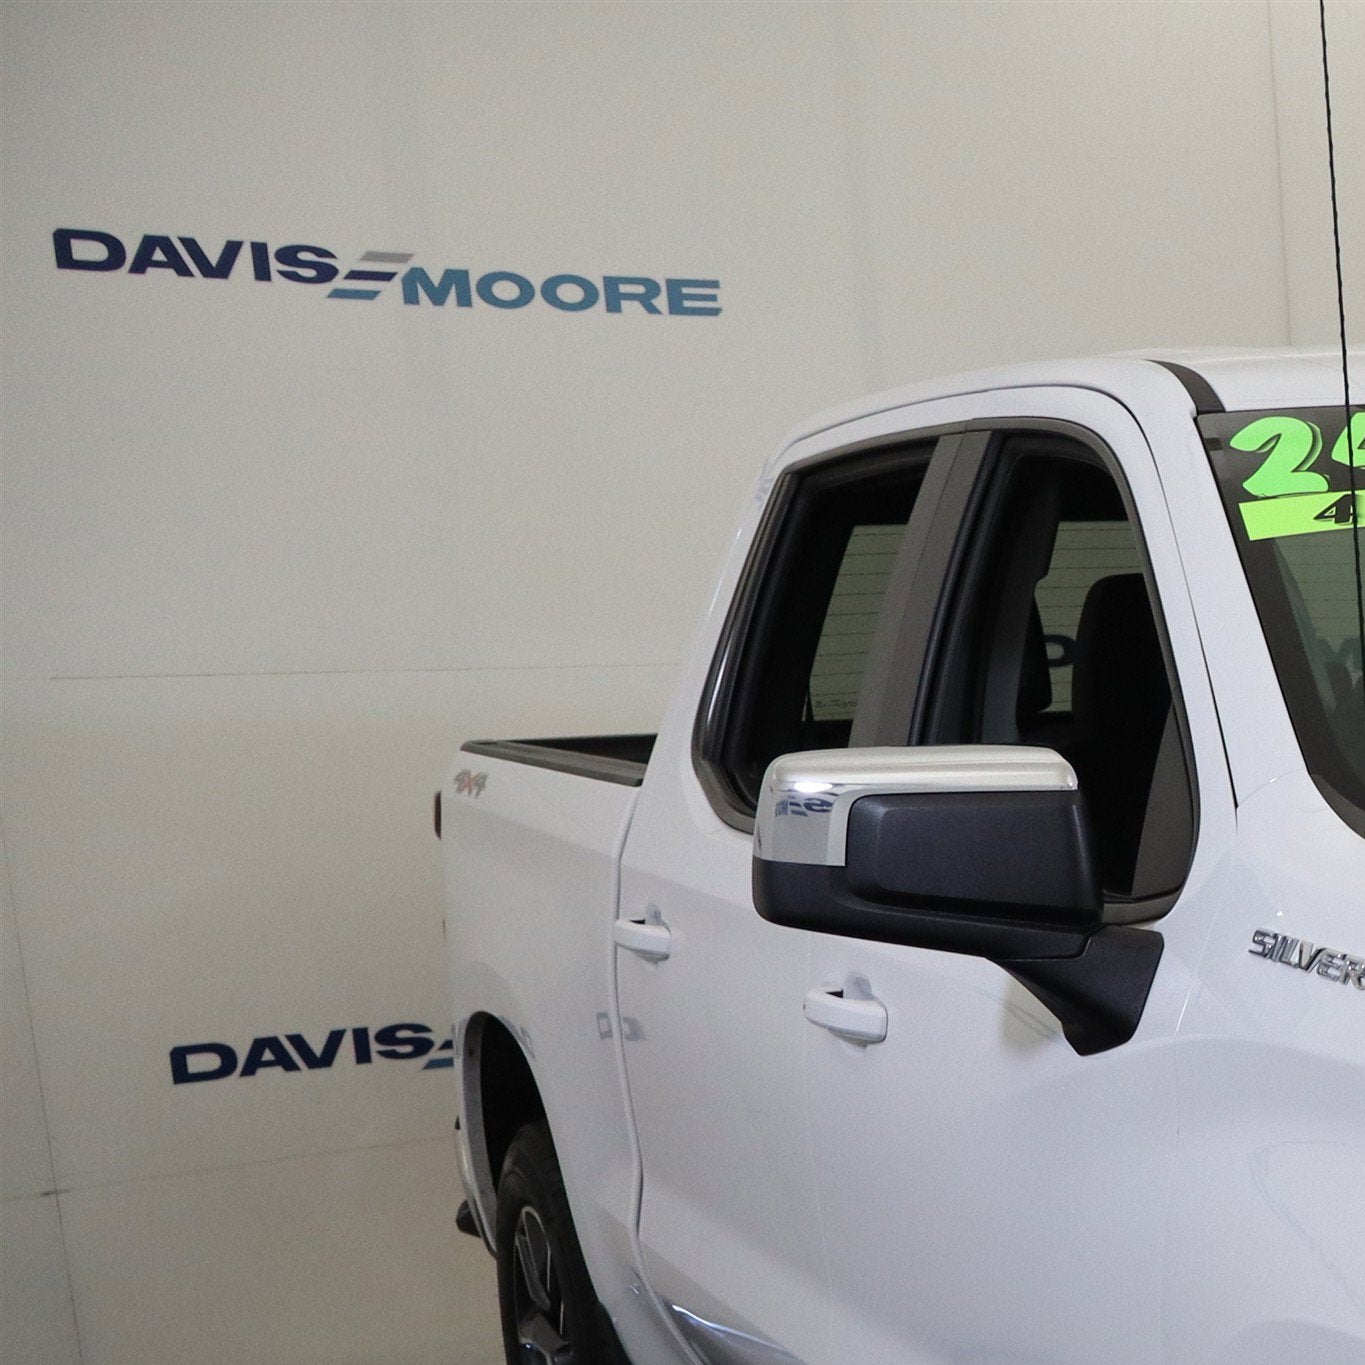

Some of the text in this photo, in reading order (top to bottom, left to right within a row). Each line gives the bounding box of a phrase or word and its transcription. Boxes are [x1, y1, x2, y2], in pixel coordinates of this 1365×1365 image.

[52, 227, 723, 317] DAVIS MOORE
[168, 1022, 436, 1086] DAVIS
